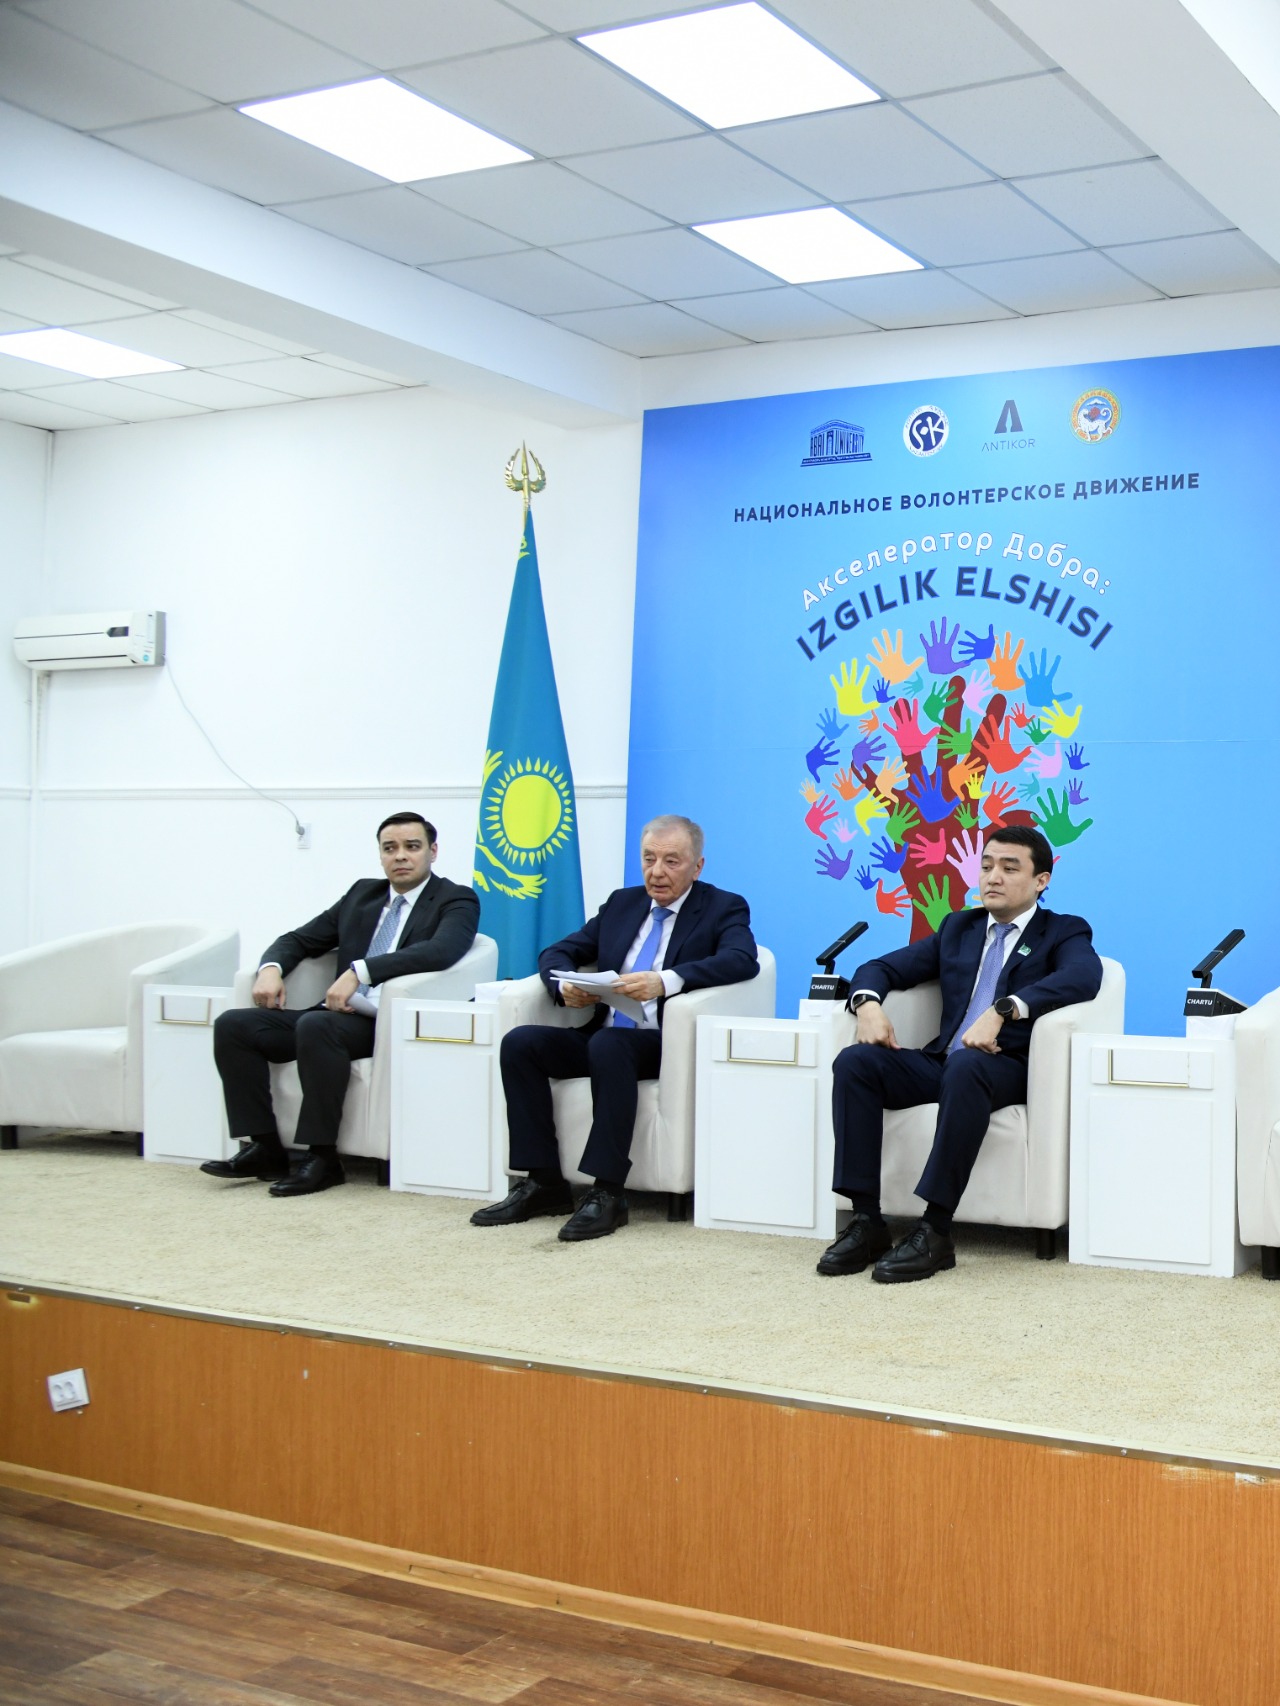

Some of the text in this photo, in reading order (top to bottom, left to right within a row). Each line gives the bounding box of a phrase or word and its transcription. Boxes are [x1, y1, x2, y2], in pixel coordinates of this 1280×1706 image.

[981, 438, 1036, 452] ANTIKOR
[733, 472, 1200, 523] НАЦИОНАЛЬНОЕ ВОЛОНТЕРСКОЕ ДВИЖЕНИЕ
[801, 531, 1112, 612] Акселератор Добра:
[795, 566, 1115, 662] IZGILIK ELSHISI
